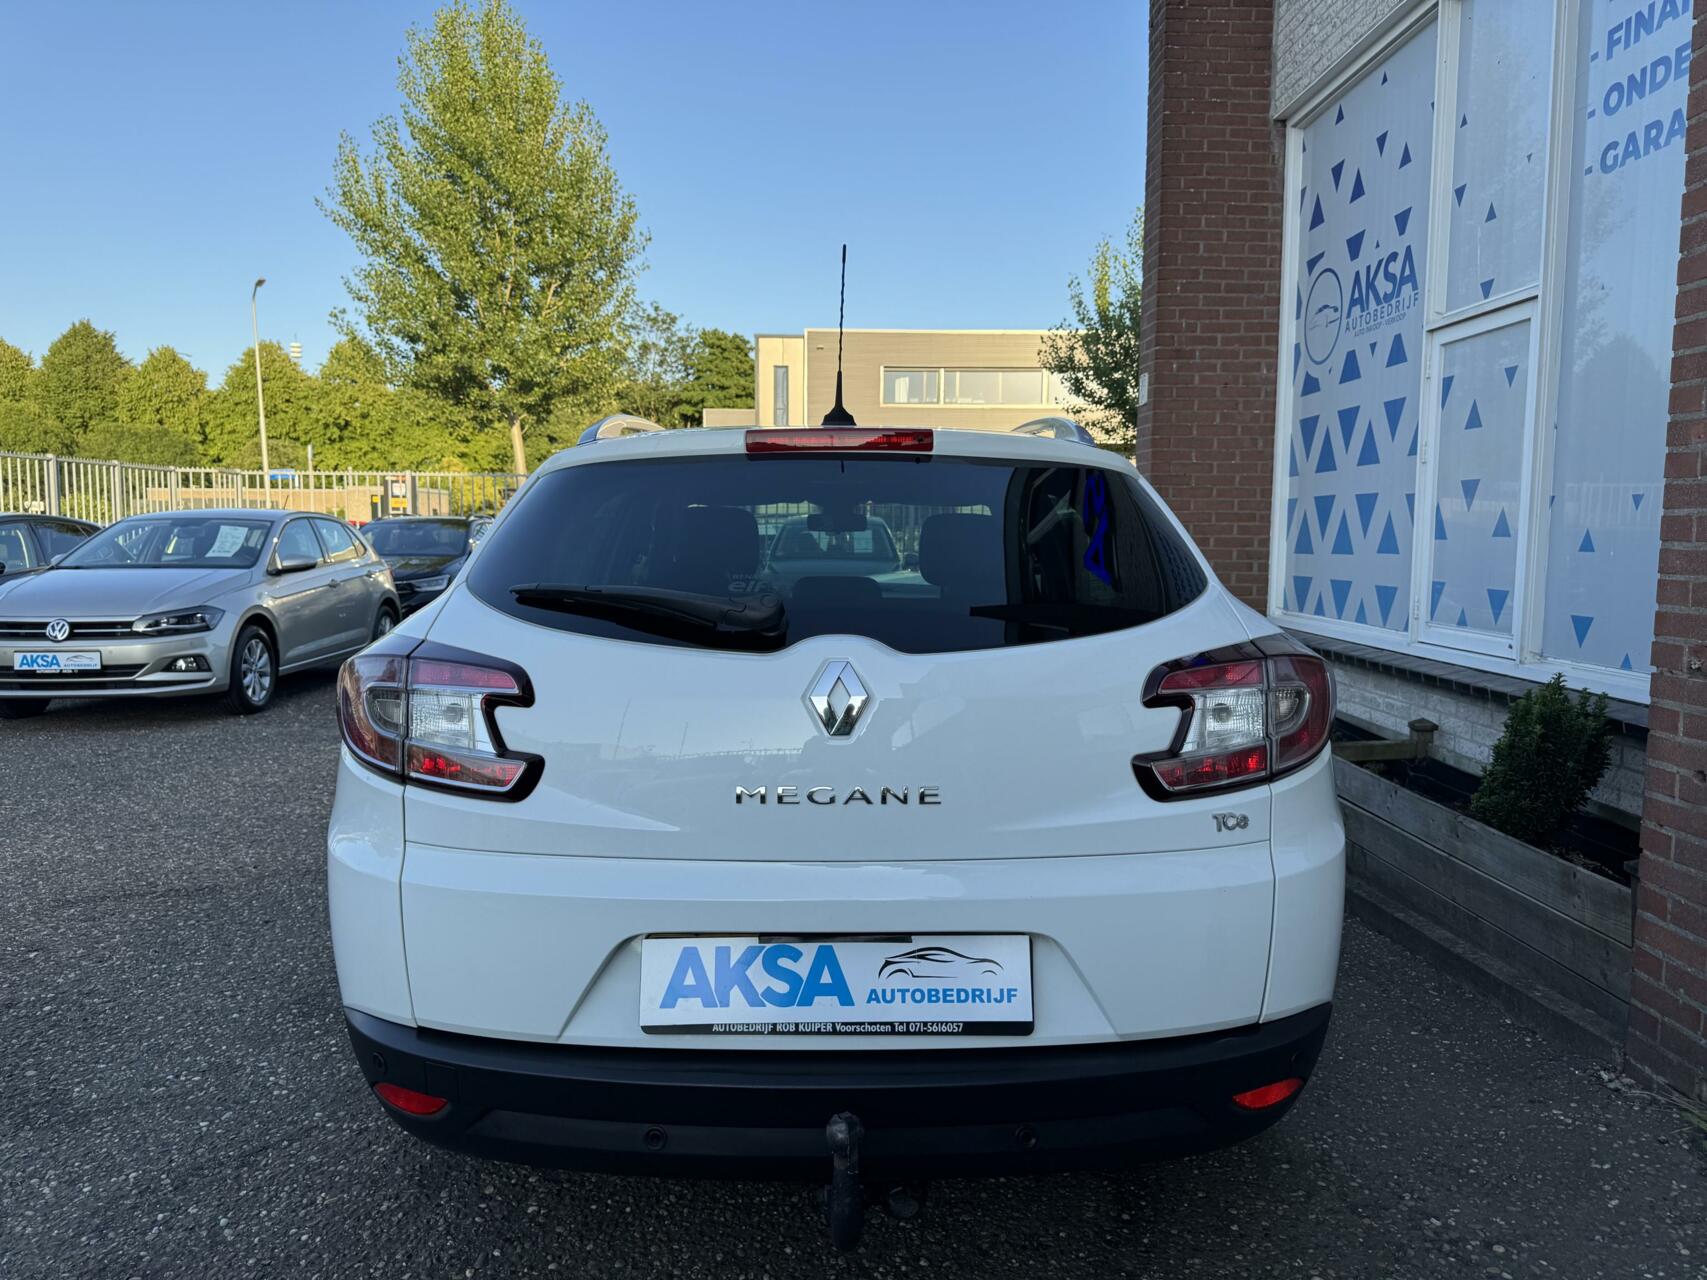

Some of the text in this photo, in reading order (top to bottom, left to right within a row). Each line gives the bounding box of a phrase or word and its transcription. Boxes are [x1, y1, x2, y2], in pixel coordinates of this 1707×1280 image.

[1600, 107, 1687, 174] GARA
[1346, 244, 1419, 320] AKSA
[1345, 292, 1419, 334] AUTOBEDRIJF
[19, 655, 61, 668] AKSA
[735, 785, 942, 805] MEGANE
[659, 944, 855, 1009] AKSA
[866, 987, 1019, 1004] AUTOBEDRIJF
[712, 1022, 964, 1034] AUTOBEDRIJF ROB KUIPER Voorschoten Tel 071-5616057
